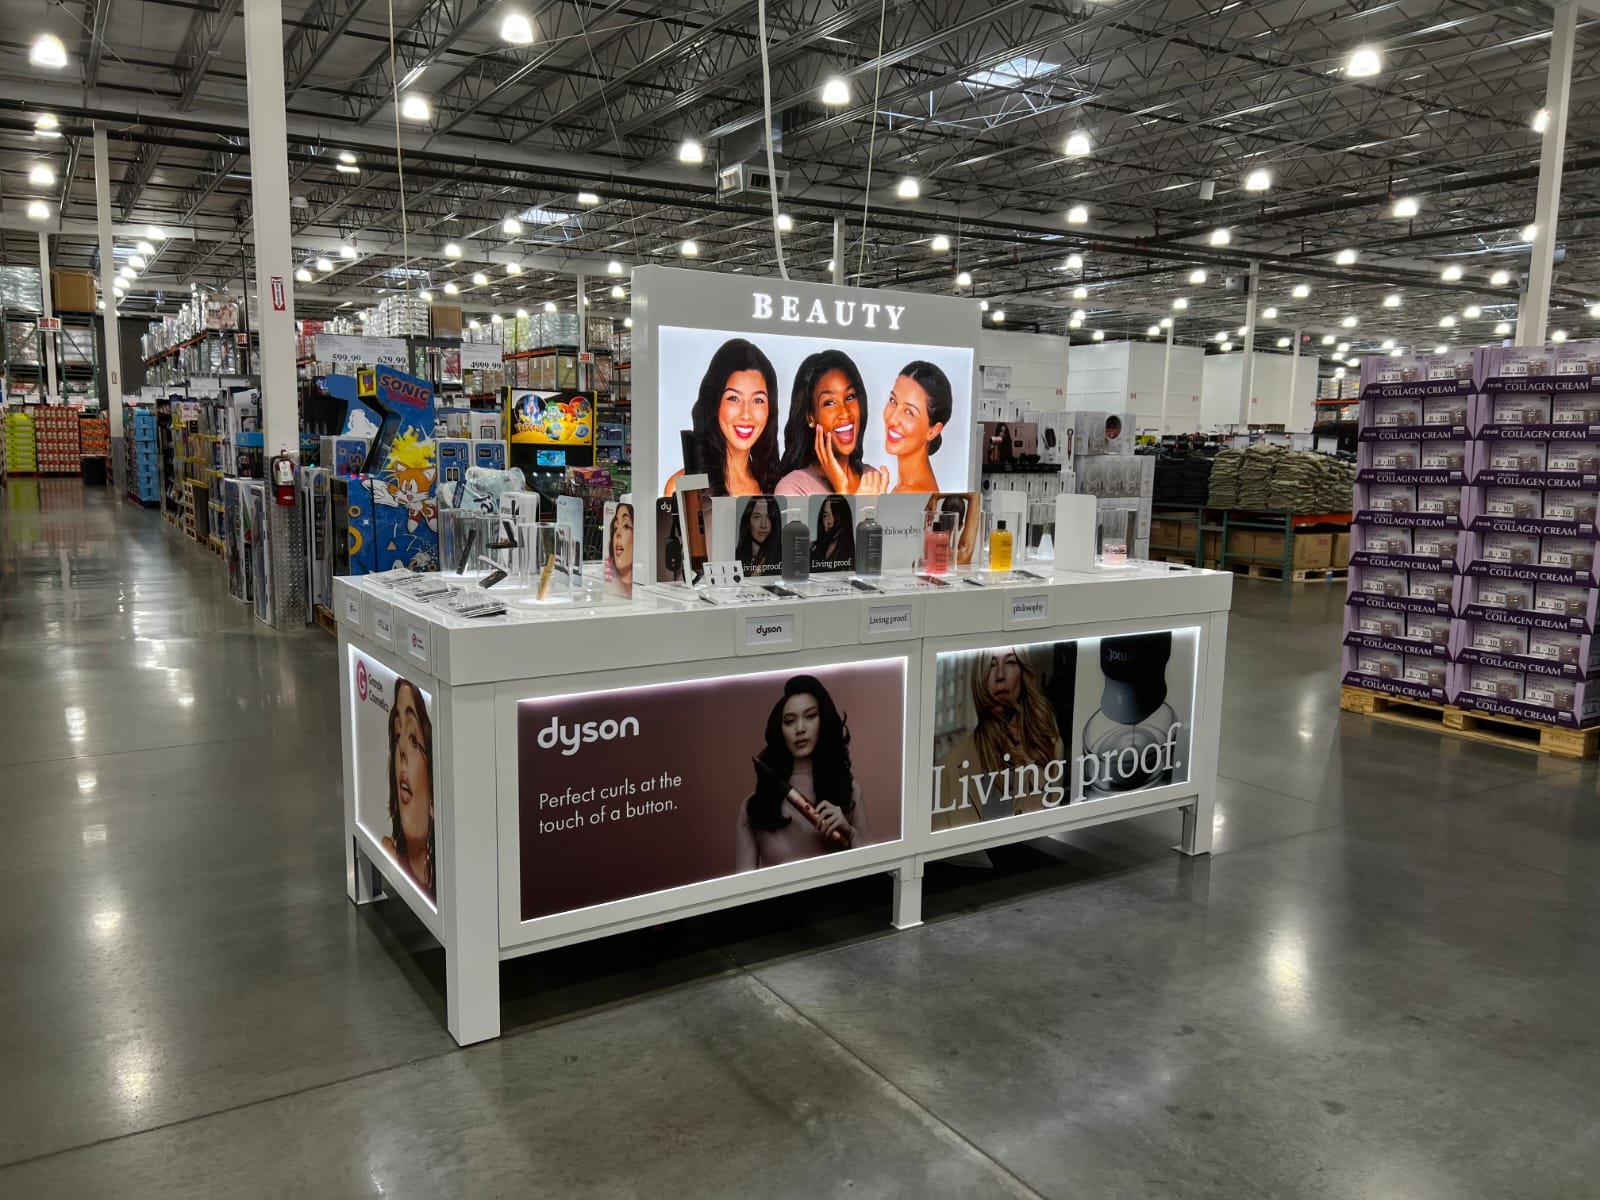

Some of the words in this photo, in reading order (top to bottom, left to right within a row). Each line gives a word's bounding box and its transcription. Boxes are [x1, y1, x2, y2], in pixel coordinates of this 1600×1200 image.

[752, 292, 905, 330] BEAUTY
[380, 374, 429, 402] SONIC
[1383, 388, 1425, 397] COLLAGEN
[1426, 386, 1456, 394] CREAM
[1505, 383, 1553, 391] COLLAGEN
[1555, 382, 1589, 390] CREAM
[1379, 432, 1420, 440] COLLAGEN
[1422, 430, 1450, 438] CREAM
[1501, 430, 1550, 438] COLLAGEN
[1552, 430, 1586, 438] CREAM
[1376, 475, 1418, 483] COLLAGEN
[1420, 475, 1448, 484] CREAM
[1497, 476, 1545, 486] COLLAGEN
[1547, 478, 1580, 487] CREAM
[1374, 517, 1414, 526] COLLAGEN
[1416, 518, 1444, 527] CREAM
[1493, 523, 1540, 533] COLLAGEN
[1544, 526, 1576, 536] CREAM
[743, 563, 761, 572] iving
[812, 560, 832, 568] Living
[1370, 559, 1410, 568] COLLAGEN
[1412, 561, 1440, 571] CREAM
[1489, 568, 1537, 579] COLLAGEN
[1540, 572, 1573, 583] CREAM
[1013, 602, 1044, 615] philosophy
[1367, 599, 1406, 610] COLLAGEN
[1408, 602, 1435, 614] CREAM
[870, 615, 887, 625] Living
[1485, 613, 1533, 625] COLLAGEN
[1535, 618, 1568, 630] CREAM
[756, 624, 782, 637] dyson
[1363, 640, 1402, 651] COLLAGEN
[1405, 646, 1432, 656] CREAM
[1480, 656, 1526, 670] COLLAGEN
[1528, 664, 1560, 676] CREAM
[1362, 680, 1401, 693] COLLAGEN
[1402, 687, 1430, 699] CREAM
[1476, 700, 1522, 716] COLLAGEN
[1524, 710, 1556, 722] CREAM
[537, 716, 640, 756] dyson
[932, 752, 1066, 815] Living
[1072, 722, 1182, 804] proof.
[540, 787, 596, 810] Perfect
[600, 778, 636, 799] curls
[641, 778, 655, 792] at
[660, 772, 682, 789] the
[540, 810, 583, 834] touch
[590, 805, 606, 824] of
[610, 810, 620, 820] a
[626, 800, 678, 818] button.
